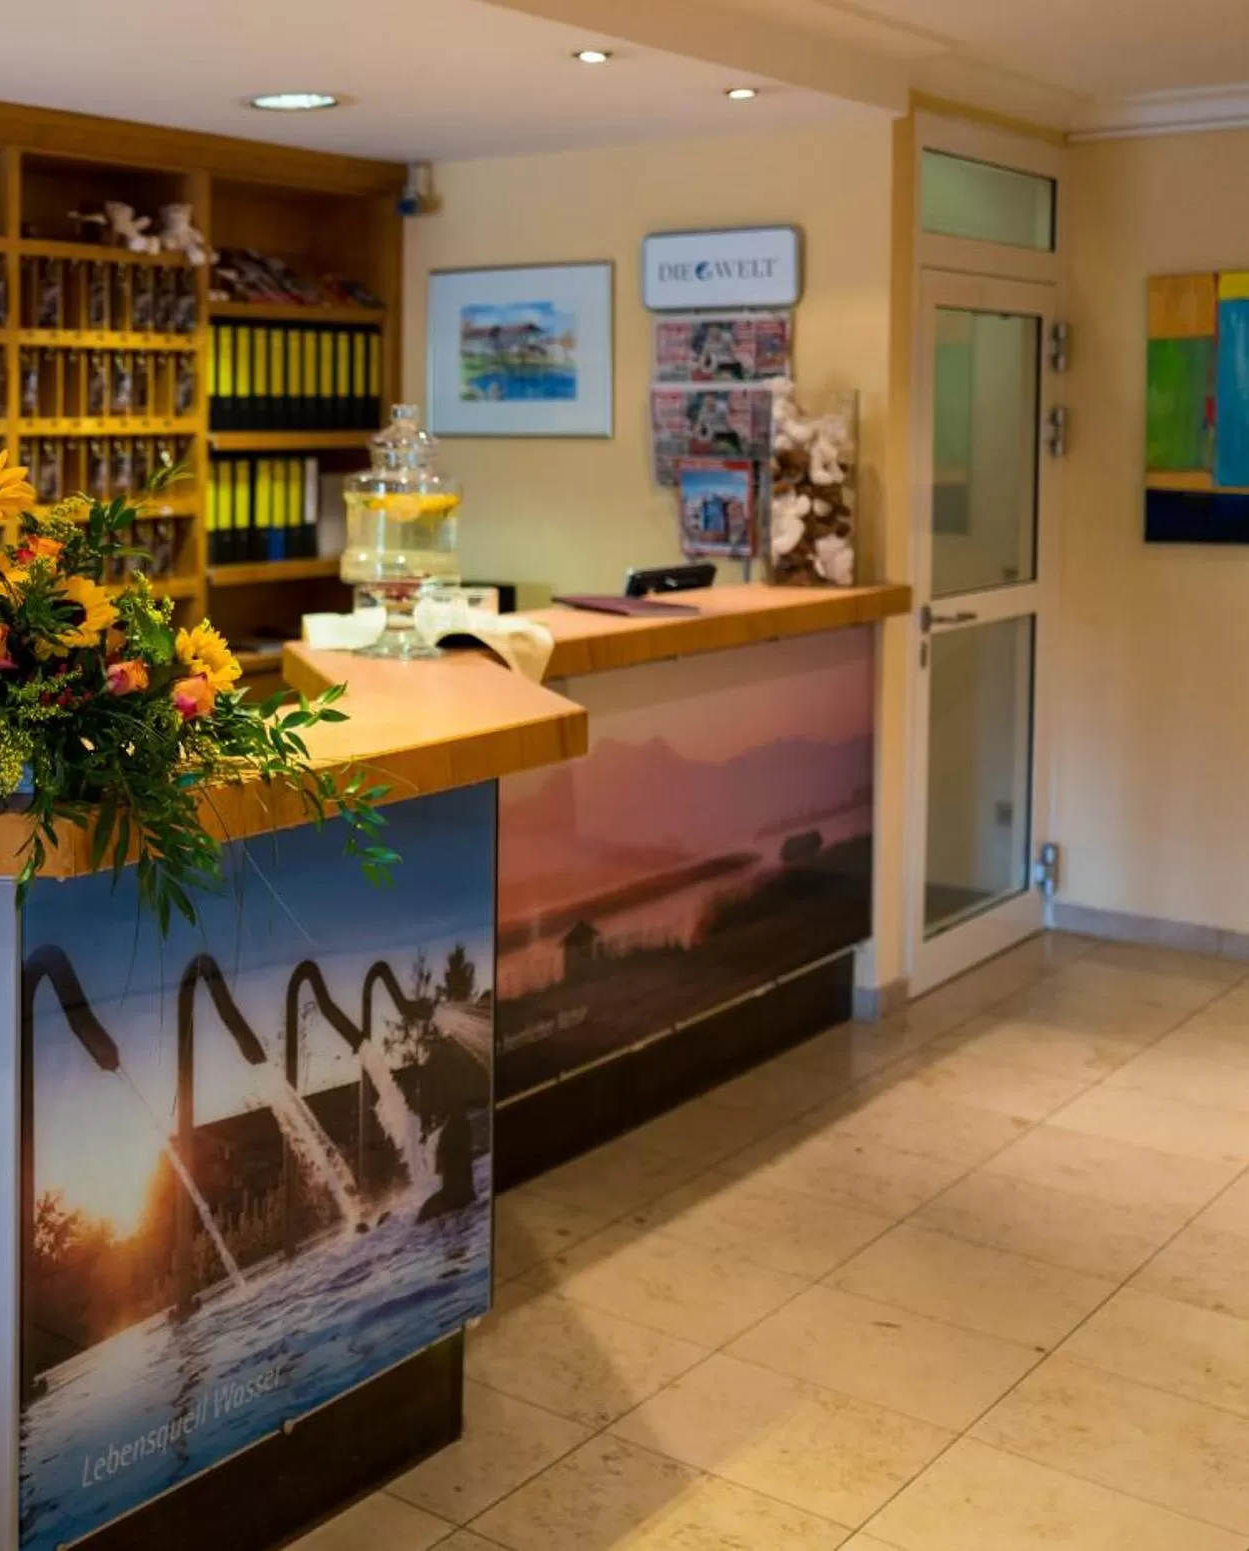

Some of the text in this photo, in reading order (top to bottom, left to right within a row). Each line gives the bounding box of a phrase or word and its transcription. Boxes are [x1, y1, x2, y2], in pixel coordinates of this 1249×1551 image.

[658, 257, 778, 282] DIE WELT
[82, 1365, 281, 1488] Lebensquell Wasser
